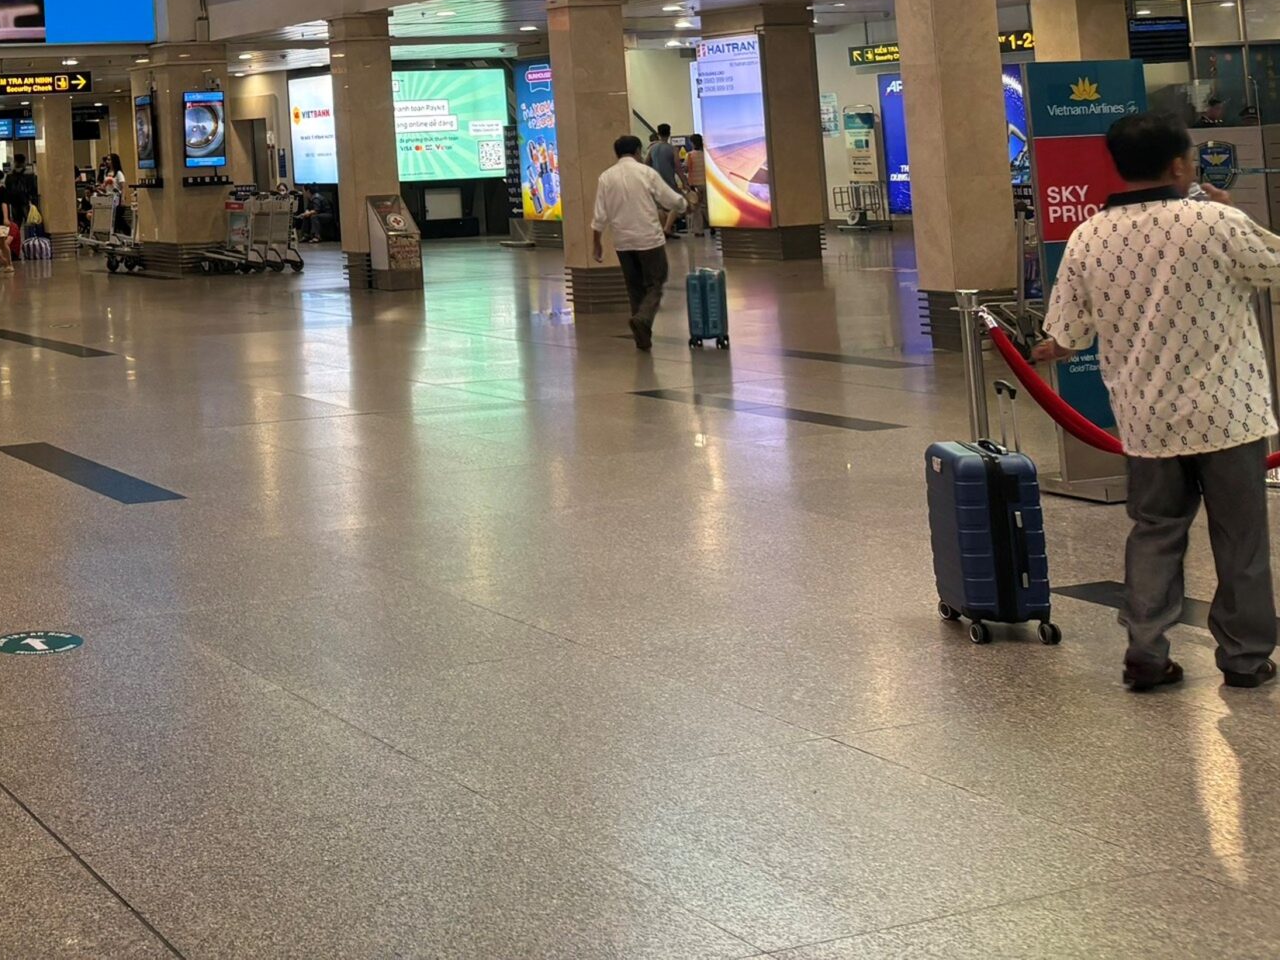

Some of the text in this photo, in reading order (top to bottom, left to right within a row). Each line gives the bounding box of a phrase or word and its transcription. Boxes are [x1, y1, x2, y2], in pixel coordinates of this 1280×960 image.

[6, 84, 53, 93] Security Check
[302, 109, 330, 119] VIETBANK
[1047, 103, 1125, 116] Vietnam Airlines
[1047, 184, 1089, 204] SKY
[1048, 203, 1105, 223] PRIO
